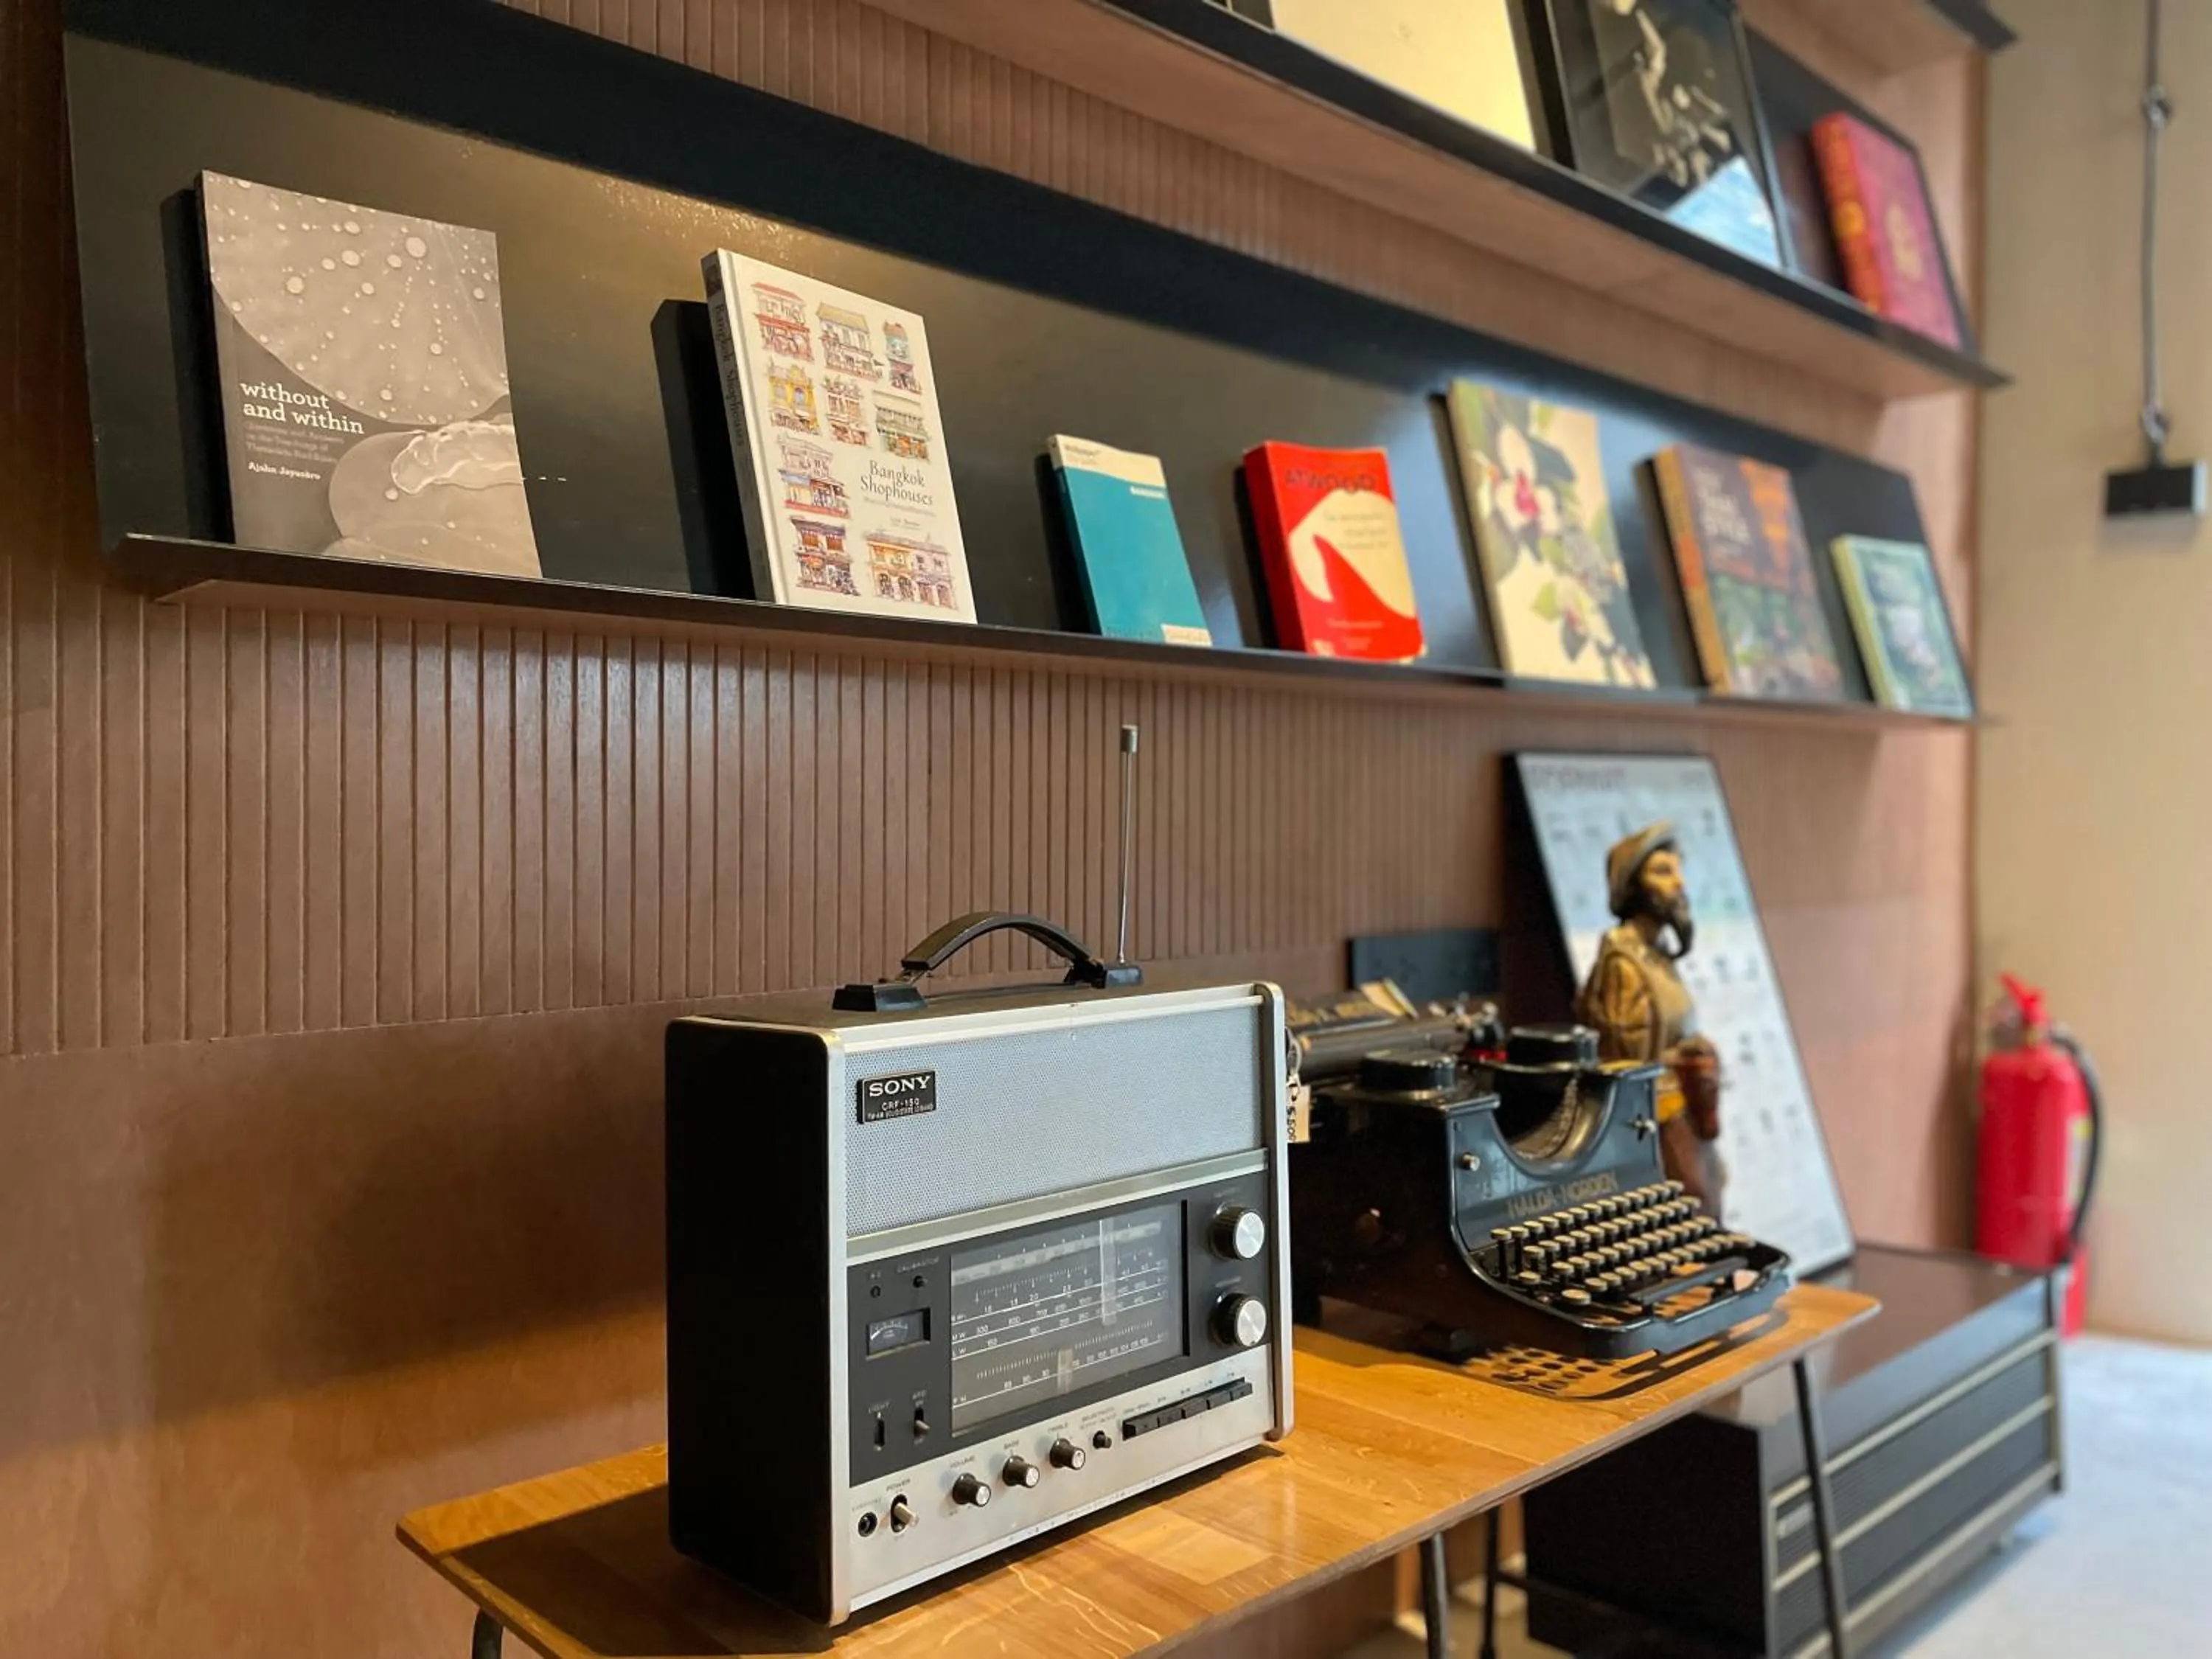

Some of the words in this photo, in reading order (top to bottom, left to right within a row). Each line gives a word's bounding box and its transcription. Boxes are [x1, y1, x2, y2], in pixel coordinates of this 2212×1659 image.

[240, 382, 330, 409] without
[243, 403, 286, 422] and
[292, 411, 365, 434] within
[869, 459, 925, 487] Bangkok
[860, 473, 933, 505] Shophouses
[869, 1075, 931, 1097] SONY
